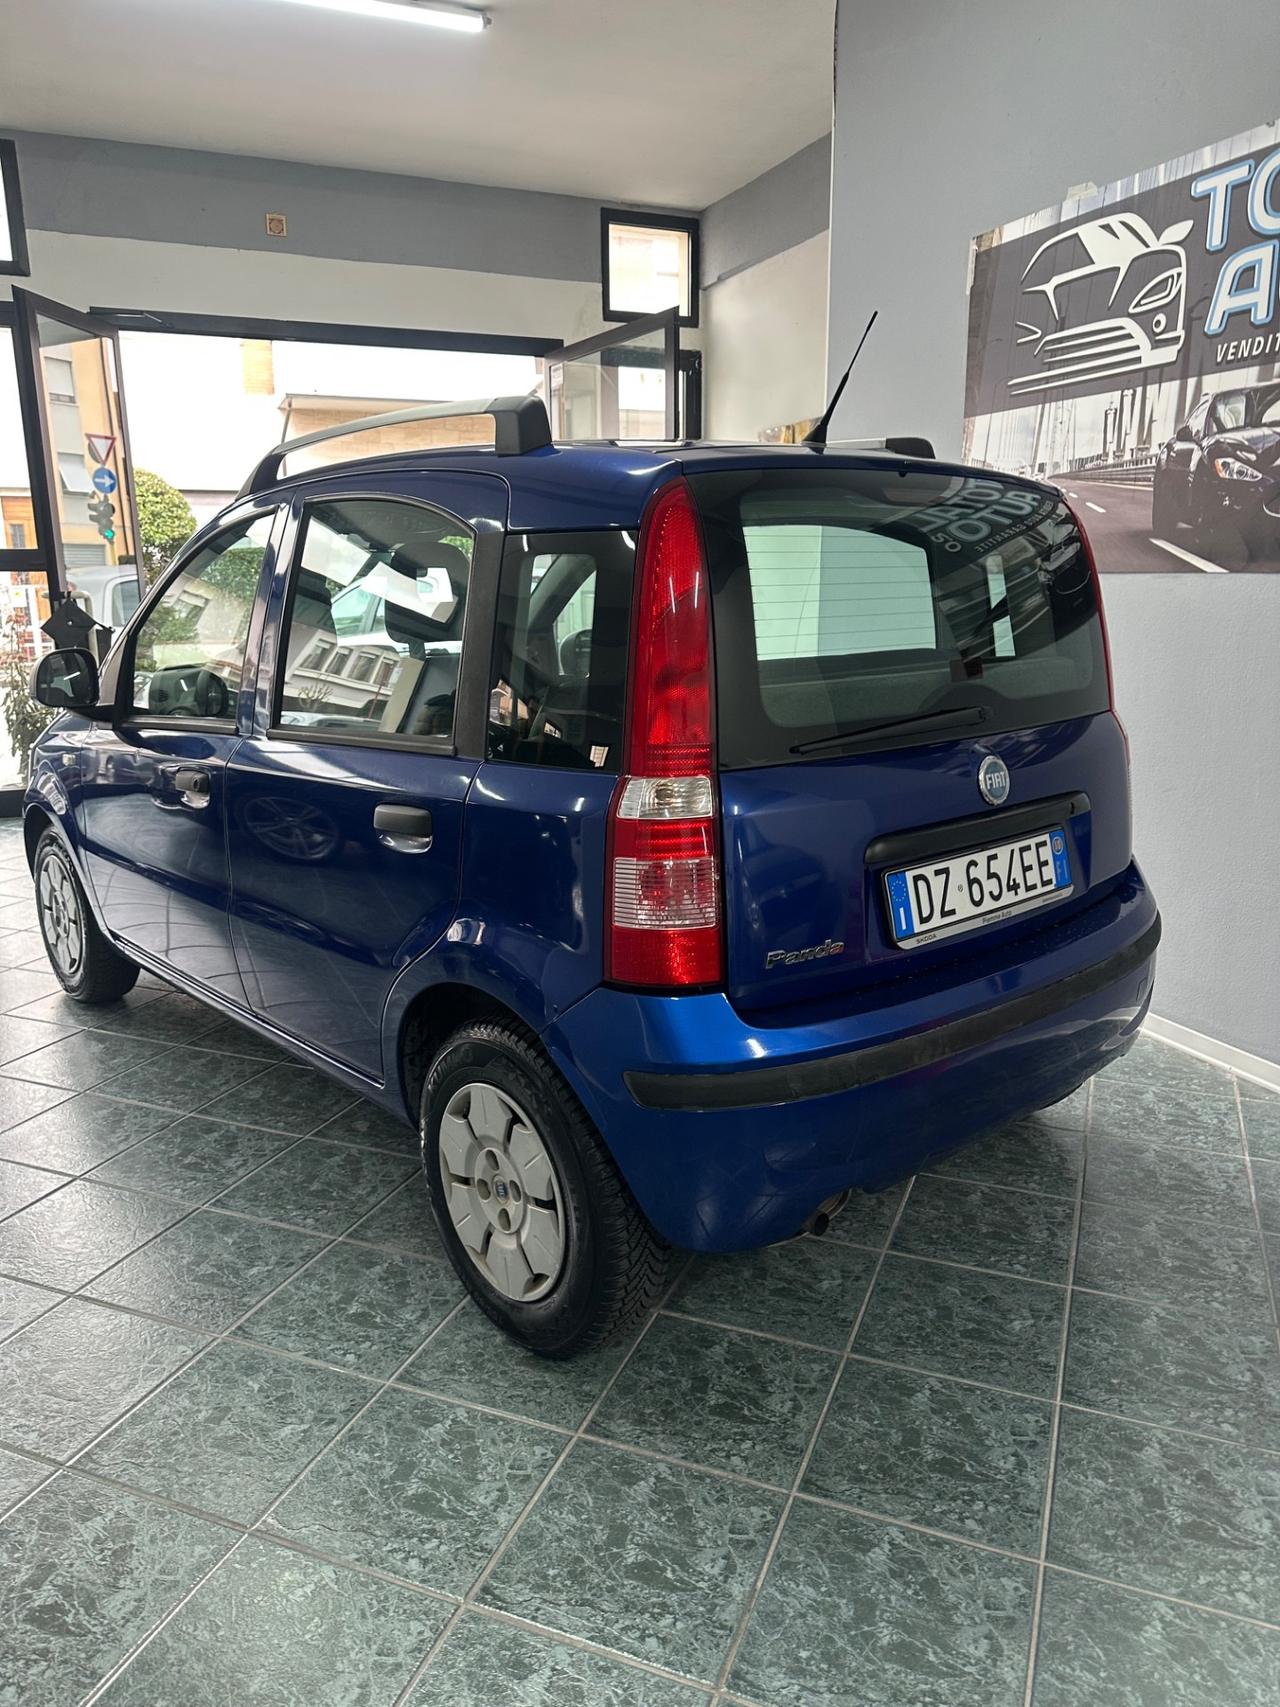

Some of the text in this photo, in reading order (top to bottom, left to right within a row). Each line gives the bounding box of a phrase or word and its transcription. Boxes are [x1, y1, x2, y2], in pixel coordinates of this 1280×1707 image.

[985, 771, 1006, 790] FIAT
[912, 839, 1054, 925] DZ 654EE
[765, 939, 845, 970] Panda
